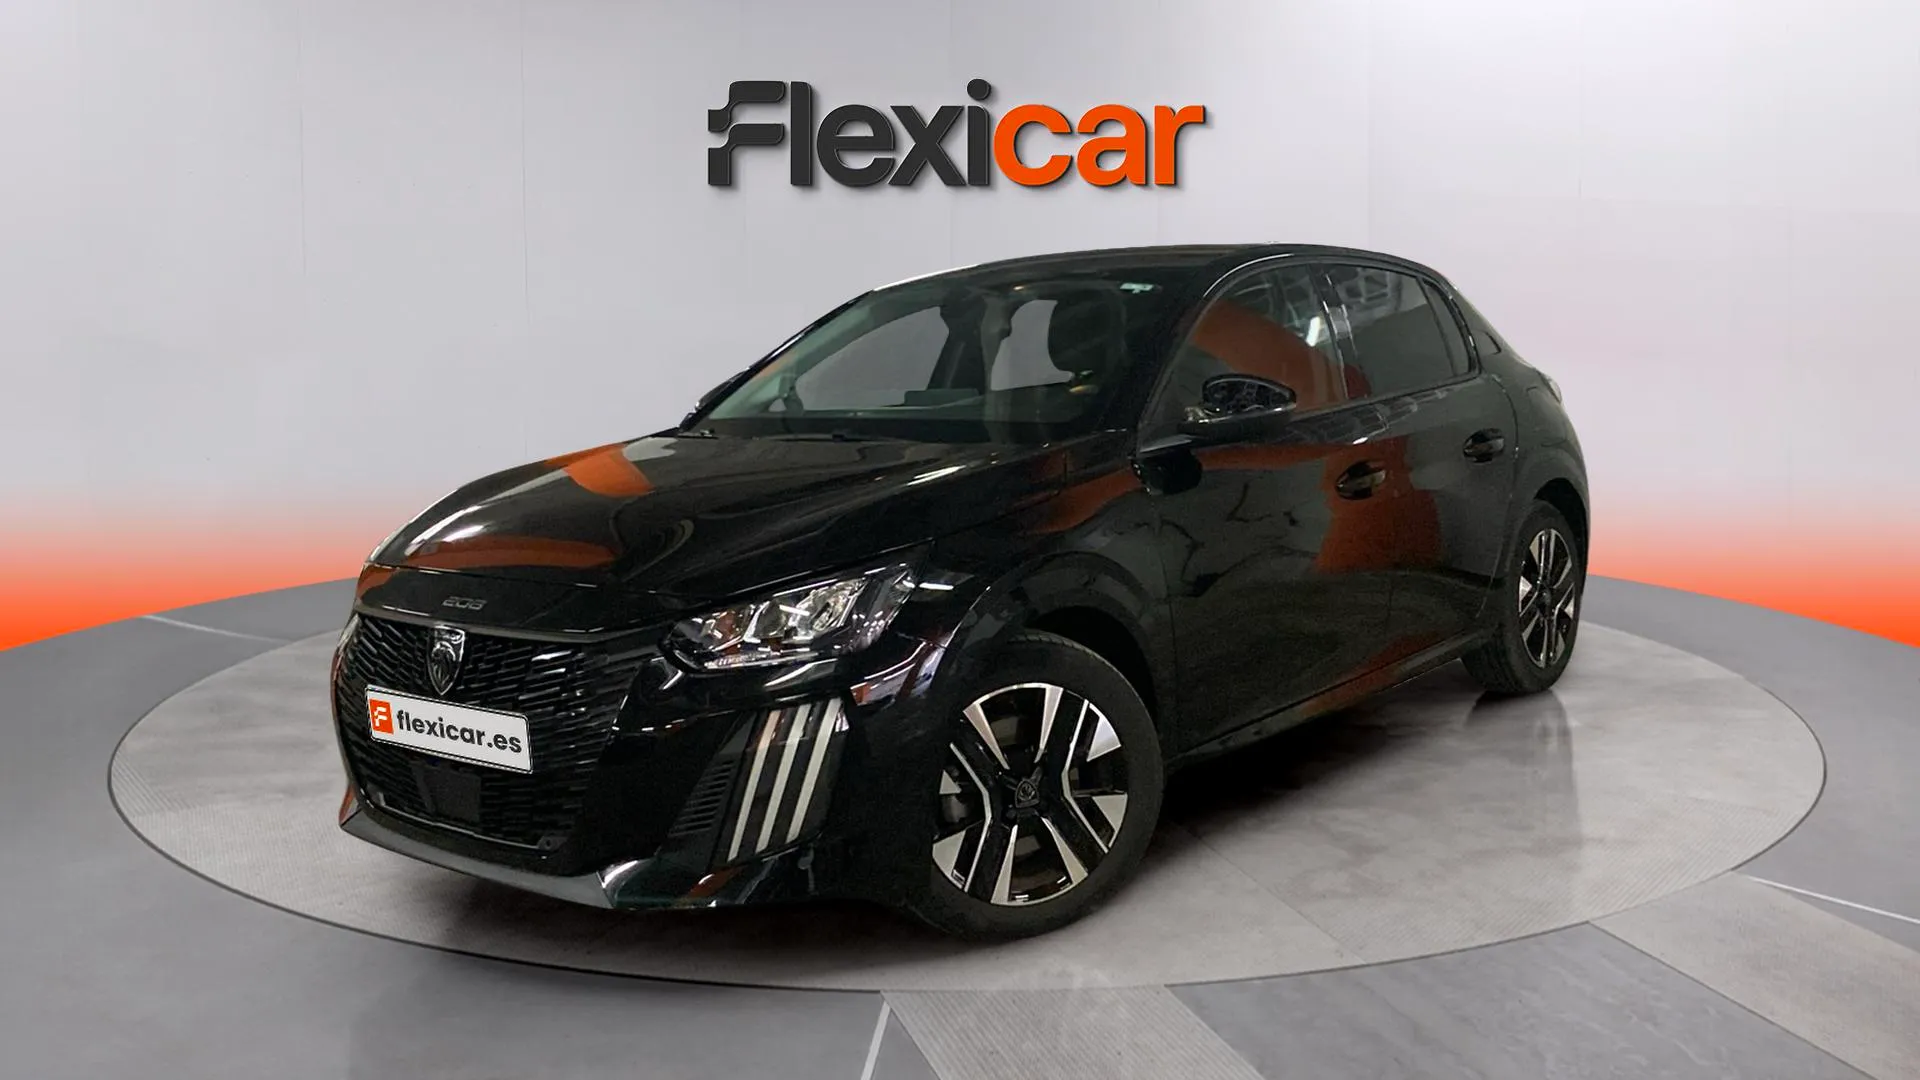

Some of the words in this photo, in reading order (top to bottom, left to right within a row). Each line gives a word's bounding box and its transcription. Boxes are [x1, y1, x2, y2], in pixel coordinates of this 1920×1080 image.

[708, 78, 1205, 187] Flexicar
[441, 596, 487, 611] 208
[396, 710, 523, 754] flexicar.es
